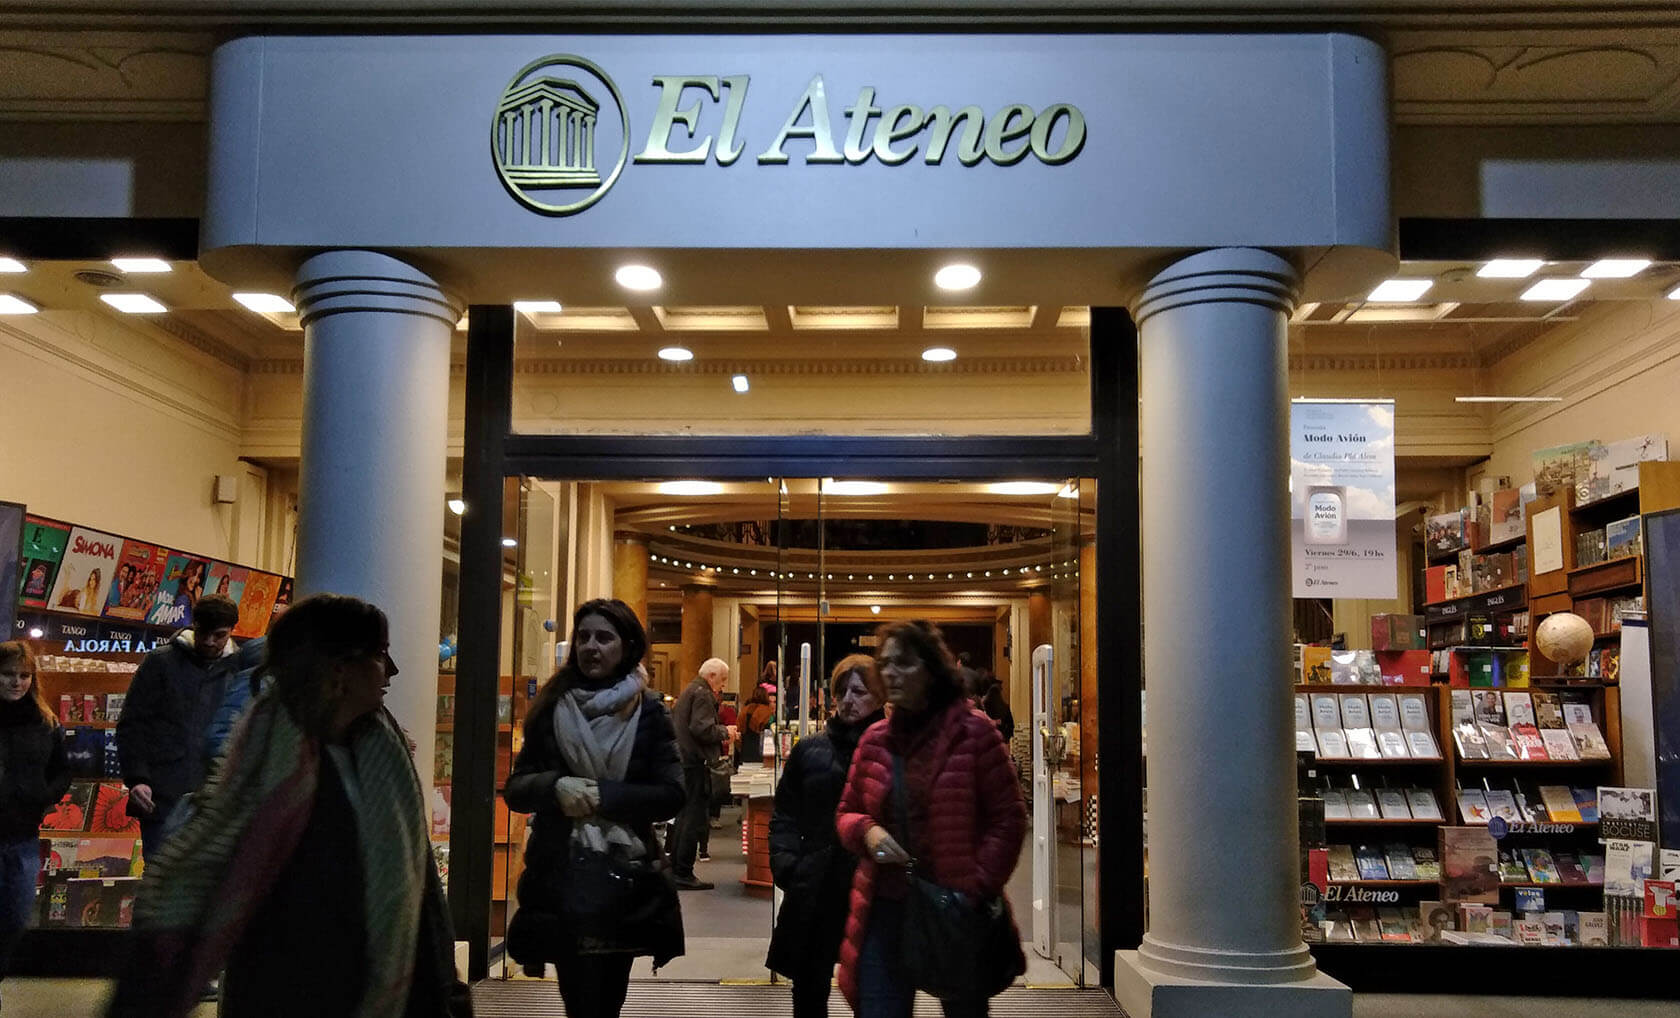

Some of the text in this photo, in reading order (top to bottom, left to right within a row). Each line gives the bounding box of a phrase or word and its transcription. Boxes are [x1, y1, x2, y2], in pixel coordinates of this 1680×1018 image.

[633, 73, 1087, 166] El Ateneo
[1303, 433, 1366, 442] Modo Avión
[72, 535, 114, 560] SIMONA
[151, 604, 185, 625] AMAR
[62, 625, 87, 636] TANGO
[110, 631, 132, 640] TANGO
[1509, 822, 1574, 833] El Ateneo
[1602, 824, 1651, 838] BOCUSE
[1324, 885, 1399, 902] El Ateneo
